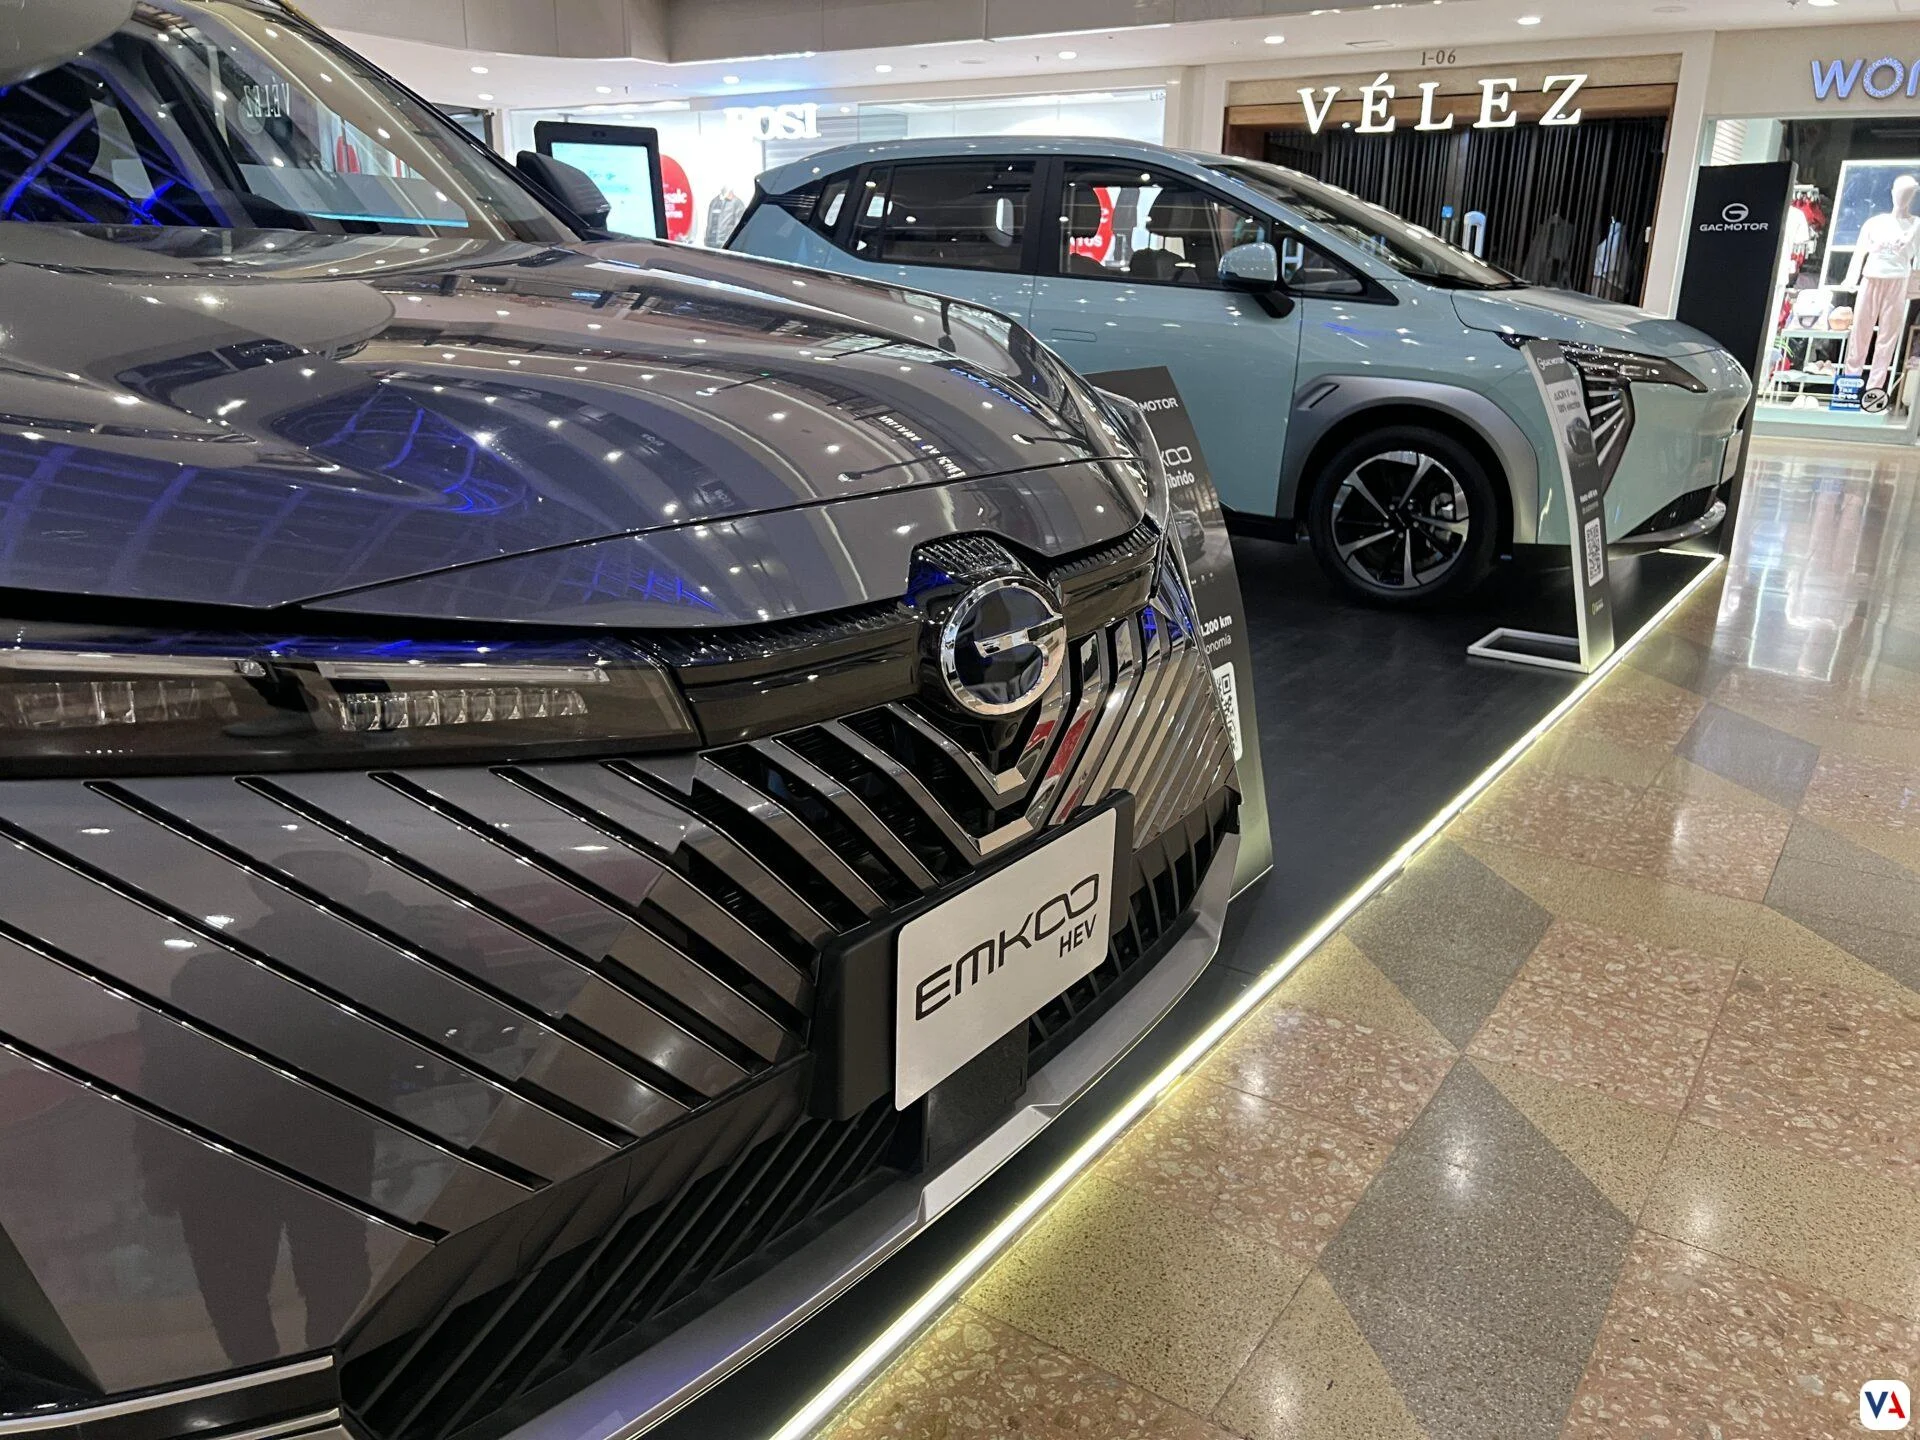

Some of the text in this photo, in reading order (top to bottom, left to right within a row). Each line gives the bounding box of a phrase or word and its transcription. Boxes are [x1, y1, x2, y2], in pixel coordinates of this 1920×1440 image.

[1296, 72, 1588, 135] VÉLEZ
[1166, 470, 1195, 489] íbrido
[1219, 615, 1233, 628] km
[915, 873, 1100, 1021] EMKOO
[1059, 914, 1097, 958] HEV
